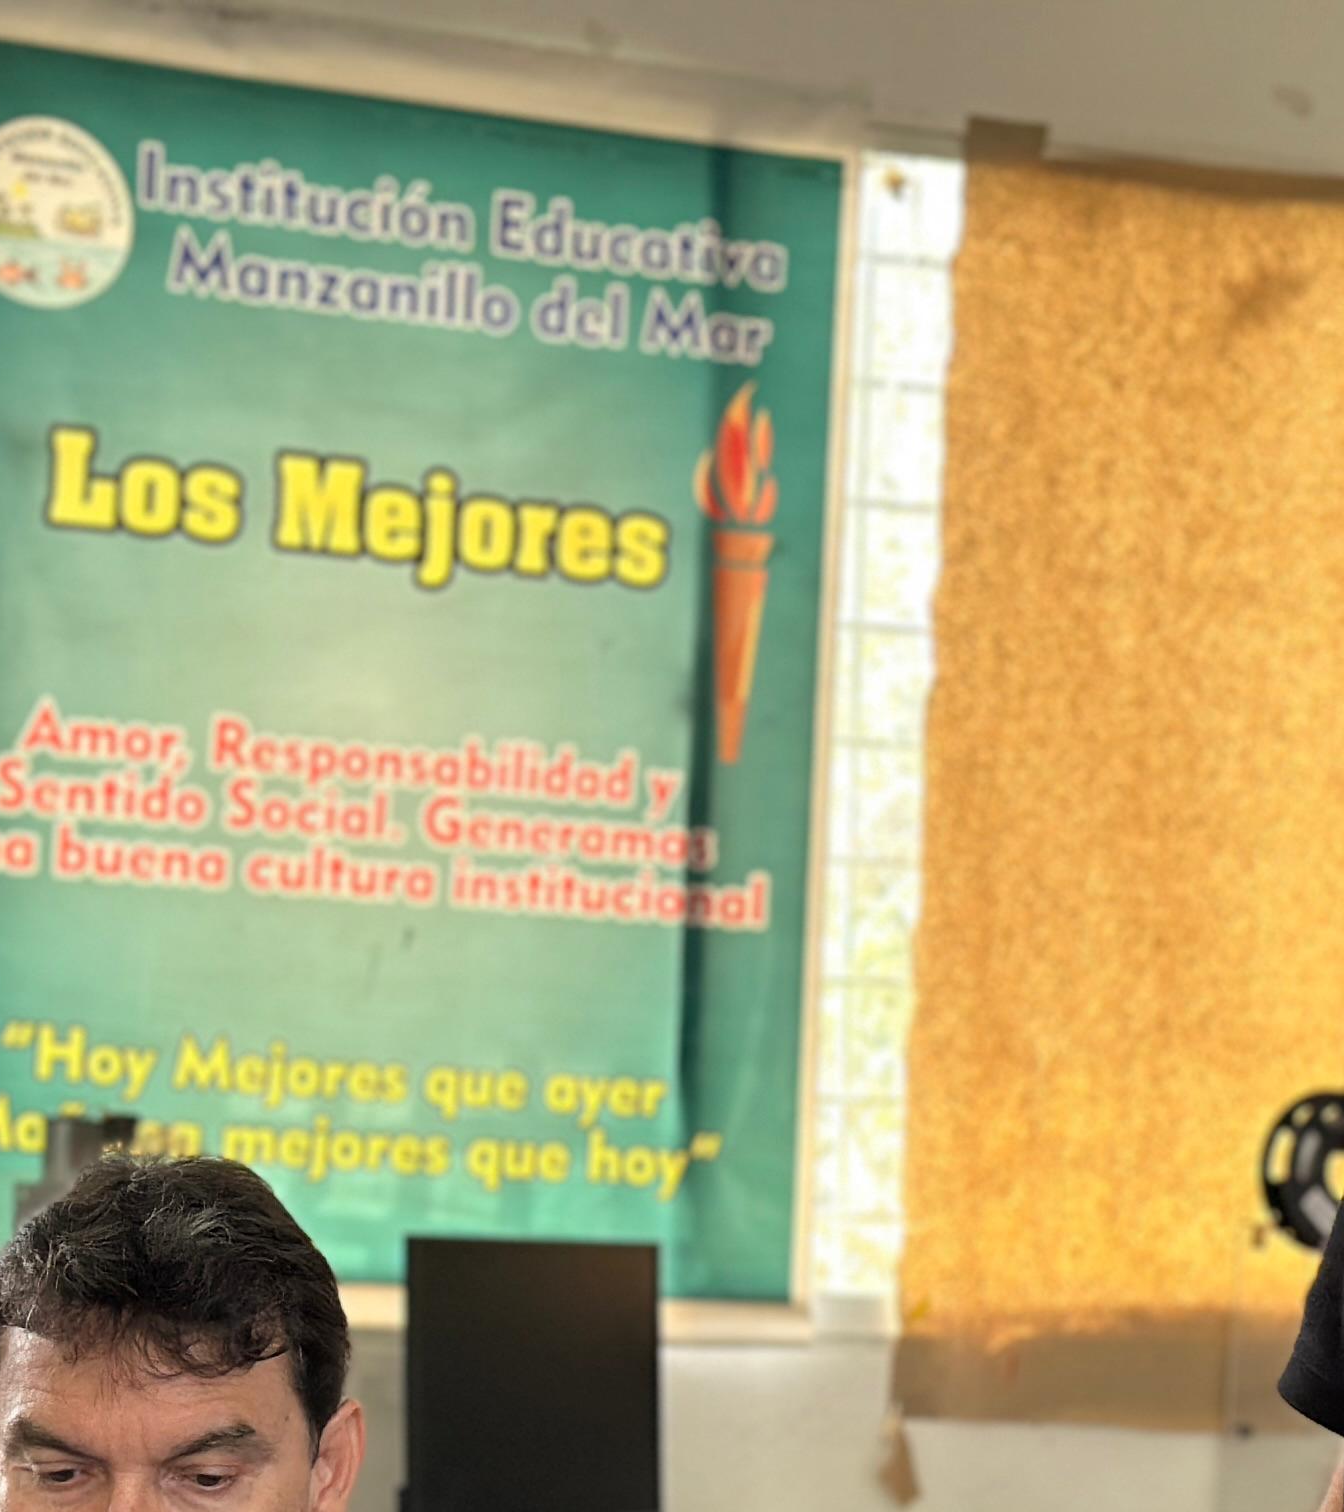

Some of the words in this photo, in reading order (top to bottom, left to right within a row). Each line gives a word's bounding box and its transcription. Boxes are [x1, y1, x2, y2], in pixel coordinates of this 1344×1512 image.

[141, 141, 473, 250] Institución
[492, 190, 787, 290] Educativa
[167, 228, 517, 333] Manzanillo
[530, 282, 627, 347] del
[641, 290, 773, 364] Mar
[47, 425, 244, 544] Los
[274, 450, 670, 590] Mejores
[22, 699, 189, 773] Amor,
[211, 718, 635, 805] Responsabilidad
[647, 765, 678, 817] y
[55, 823, 229, 889] buena
[245, 842, 436, 905] cultura
[452, 856, 769, 930] institucional
[173, 1037, 412, 1107] Mejores
[424, 1064, 529, 1115] que
[543, 1070, 668, 1128] ayer
[223, 1115, 451, 1181] mejores
[465, 1138, 569, 1192] que
